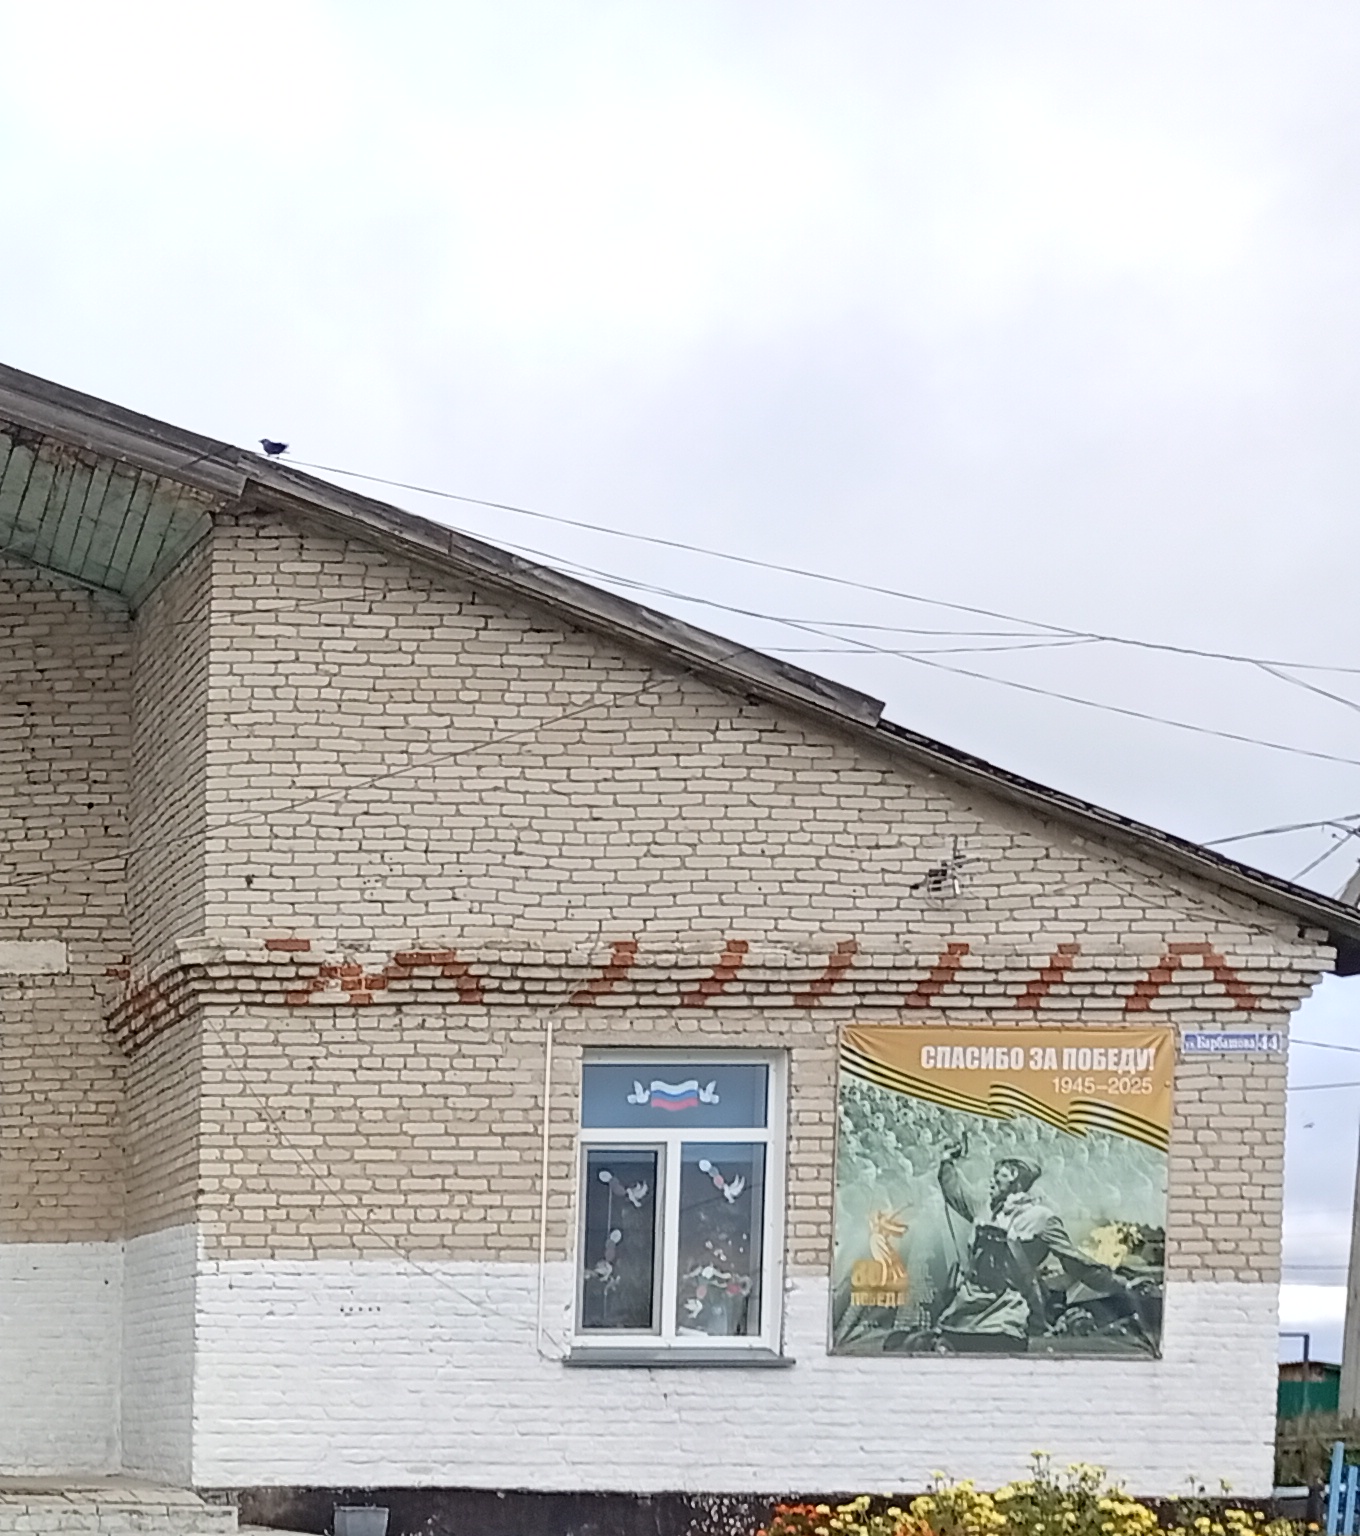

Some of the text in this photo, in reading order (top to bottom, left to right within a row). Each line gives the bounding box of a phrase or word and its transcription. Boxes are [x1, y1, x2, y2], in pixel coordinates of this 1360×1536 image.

[920, 1046, 1156, 1074] СПАСИБО ЗА ПОБЕДУ!
